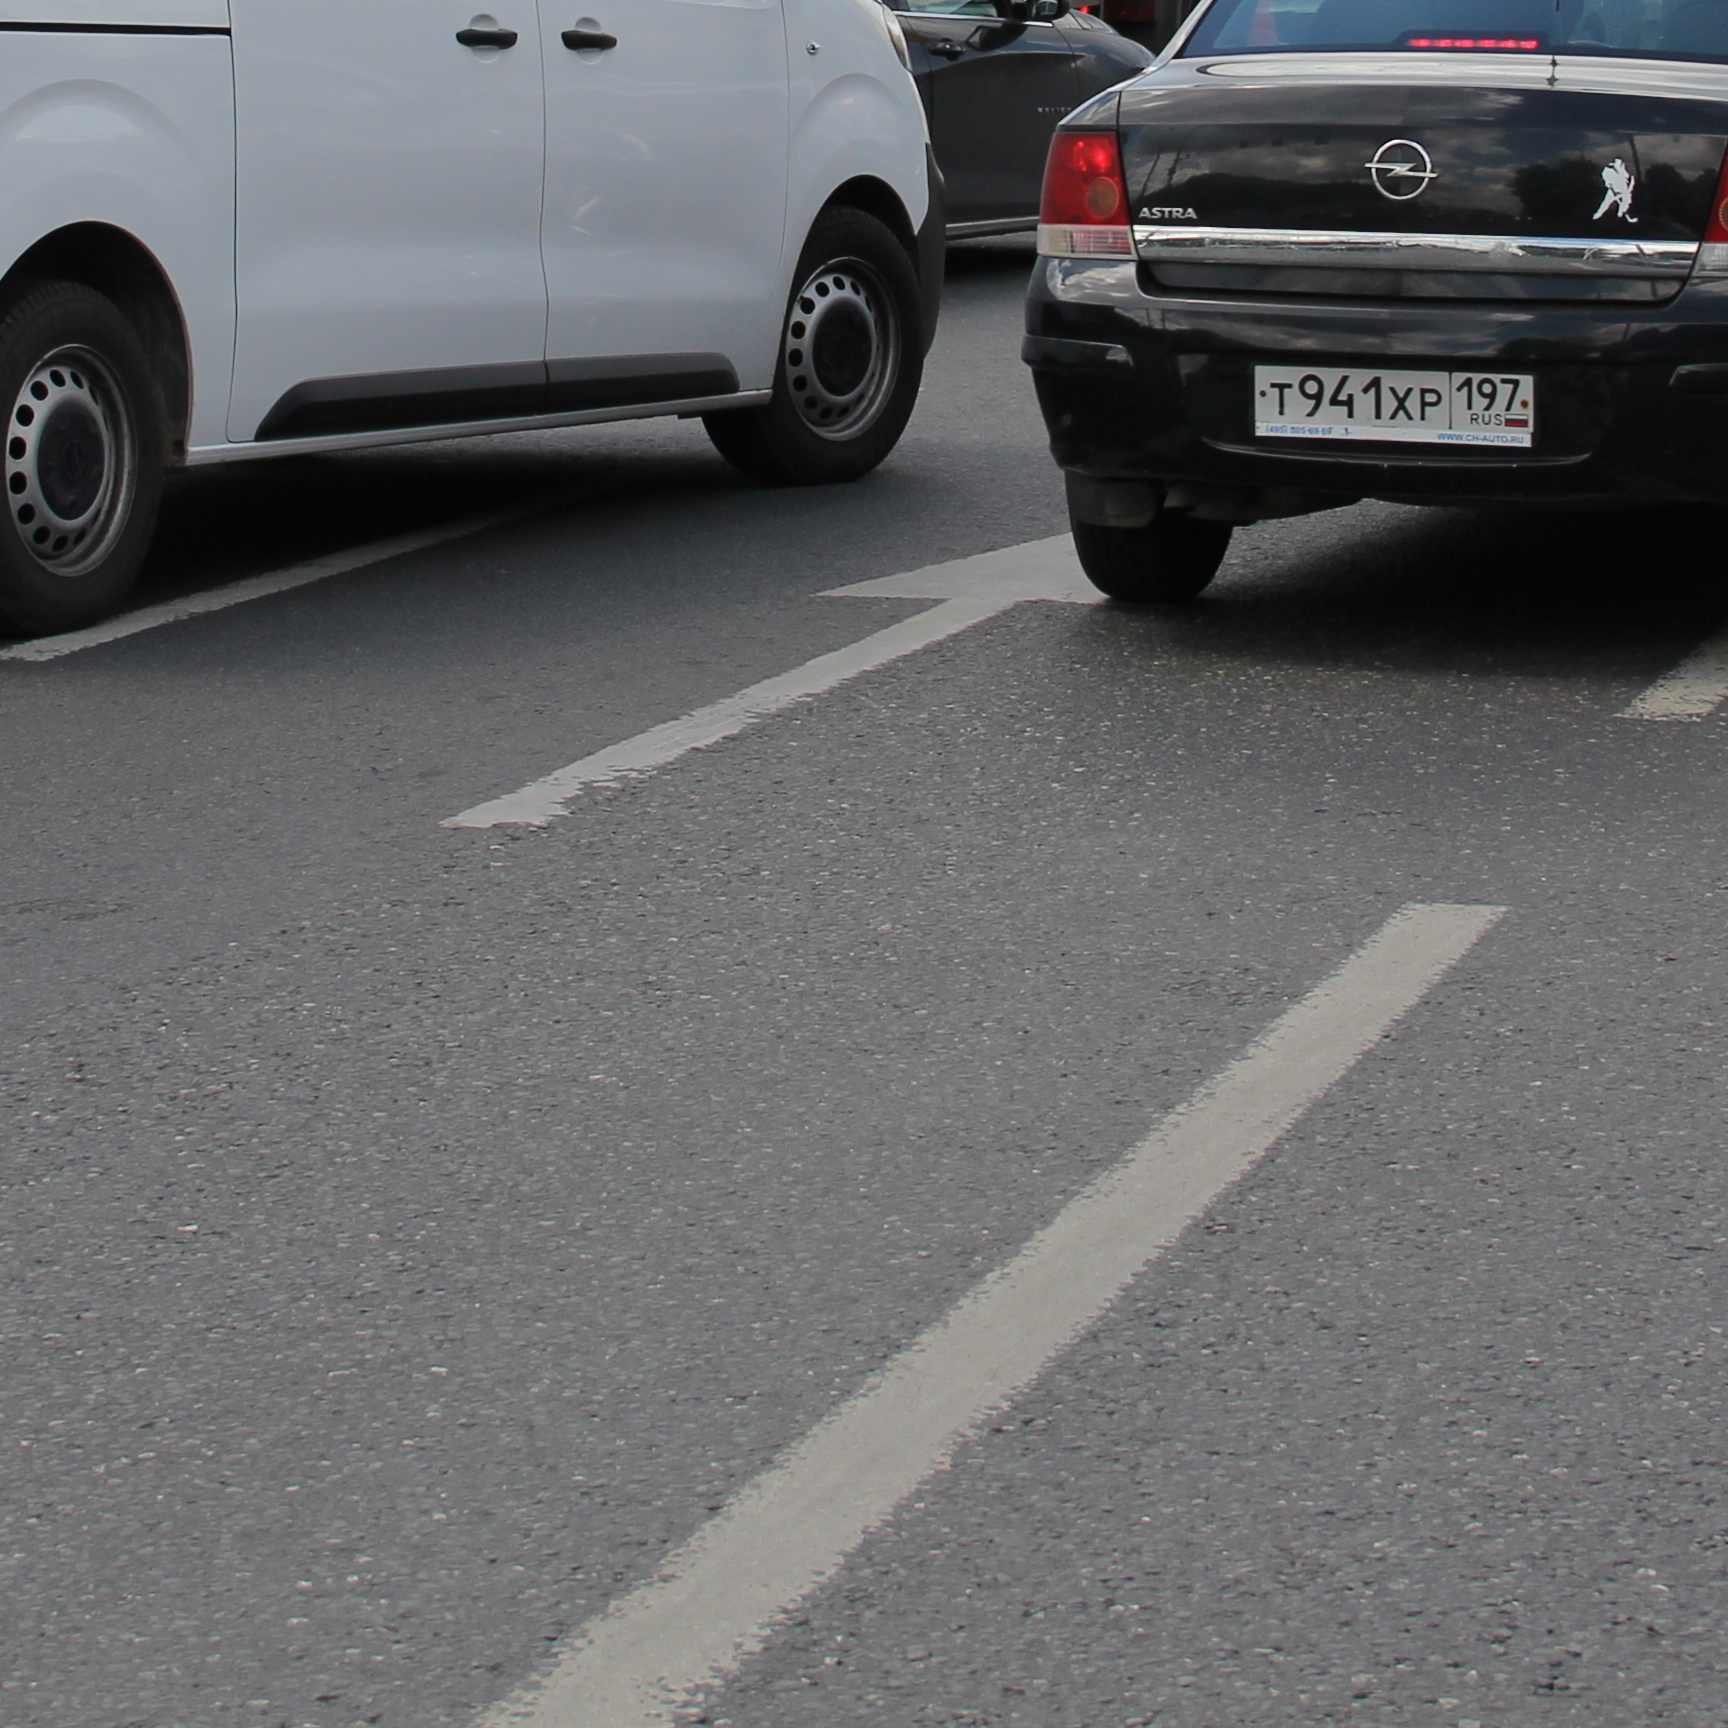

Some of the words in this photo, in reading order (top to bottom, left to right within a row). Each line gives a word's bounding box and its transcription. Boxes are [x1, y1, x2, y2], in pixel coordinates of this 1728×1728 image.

[1138, 205, 1198, 220] ASTRA
[1269, 373, 1443, 421] Т941ХР
[1455, 377, 1521, 412] 197
[1470, 412, 1504, 426] RUS
